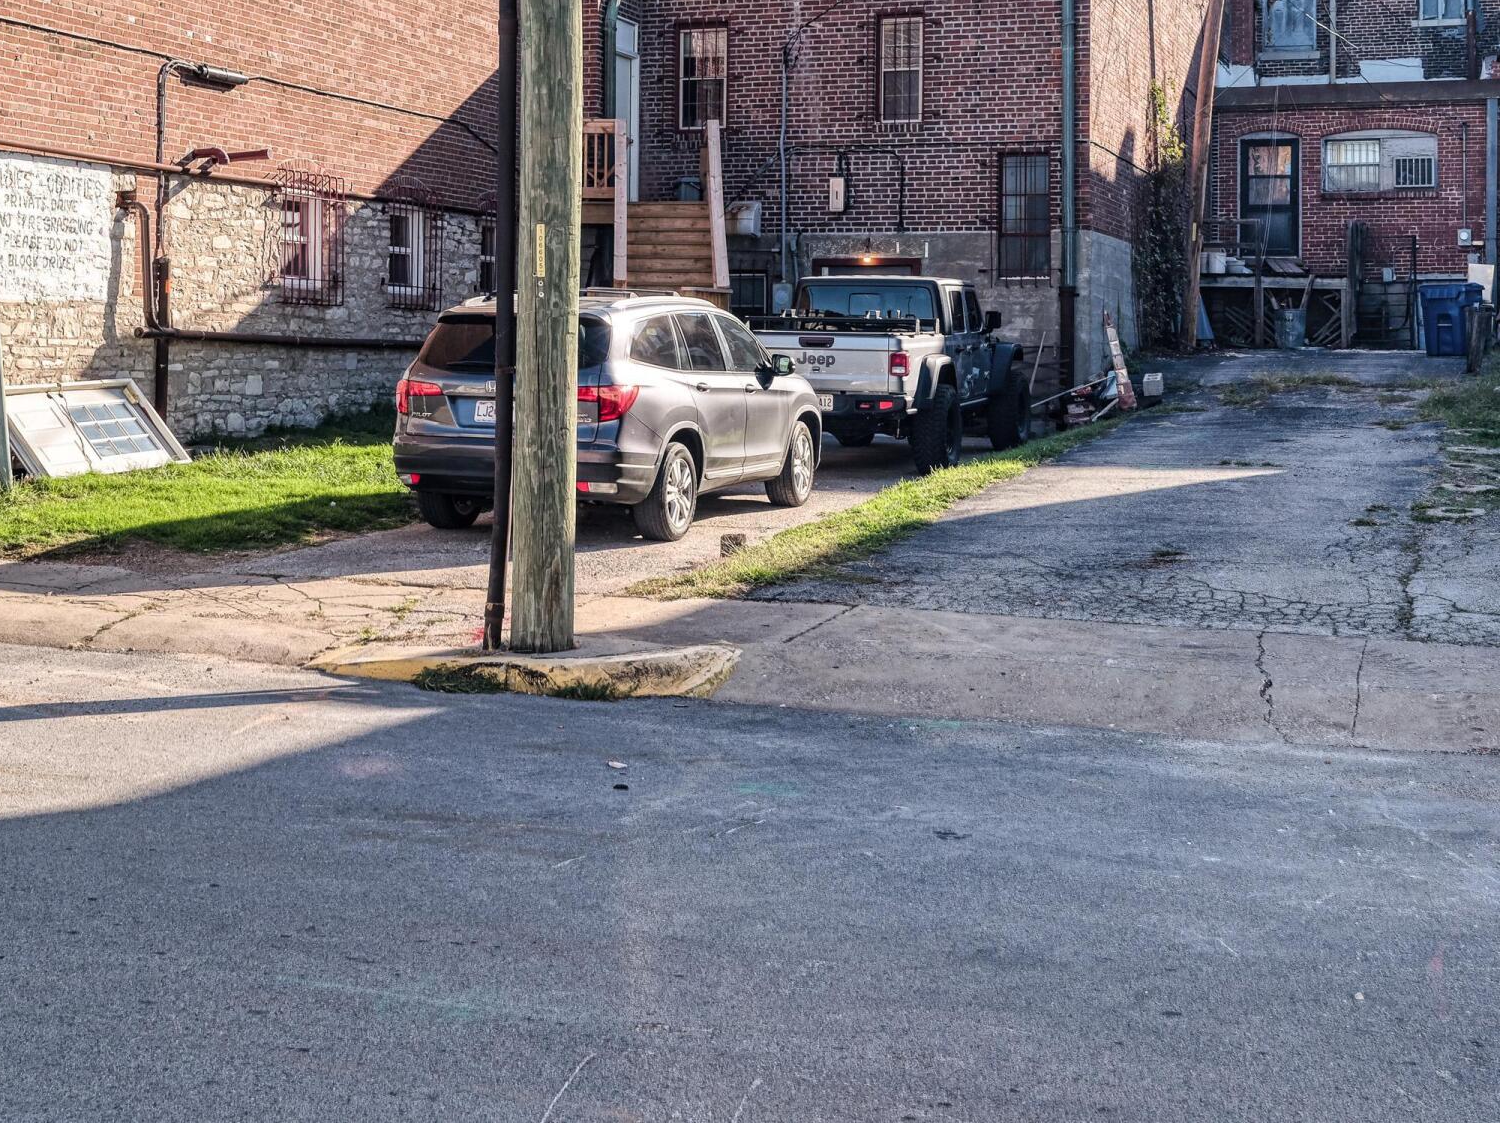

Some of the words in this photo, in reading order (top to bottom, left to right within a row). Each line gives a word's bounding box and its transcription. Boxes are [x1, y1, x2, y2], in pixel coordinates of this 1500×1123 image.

[50, 198, 79, 213] DRIVE
[48, 237, 62, 251] DO
[64, 238, 84, 253] NOT
[7, 253, 39, 268] BLOCK
[796, 351, 836, 367] Jeep
